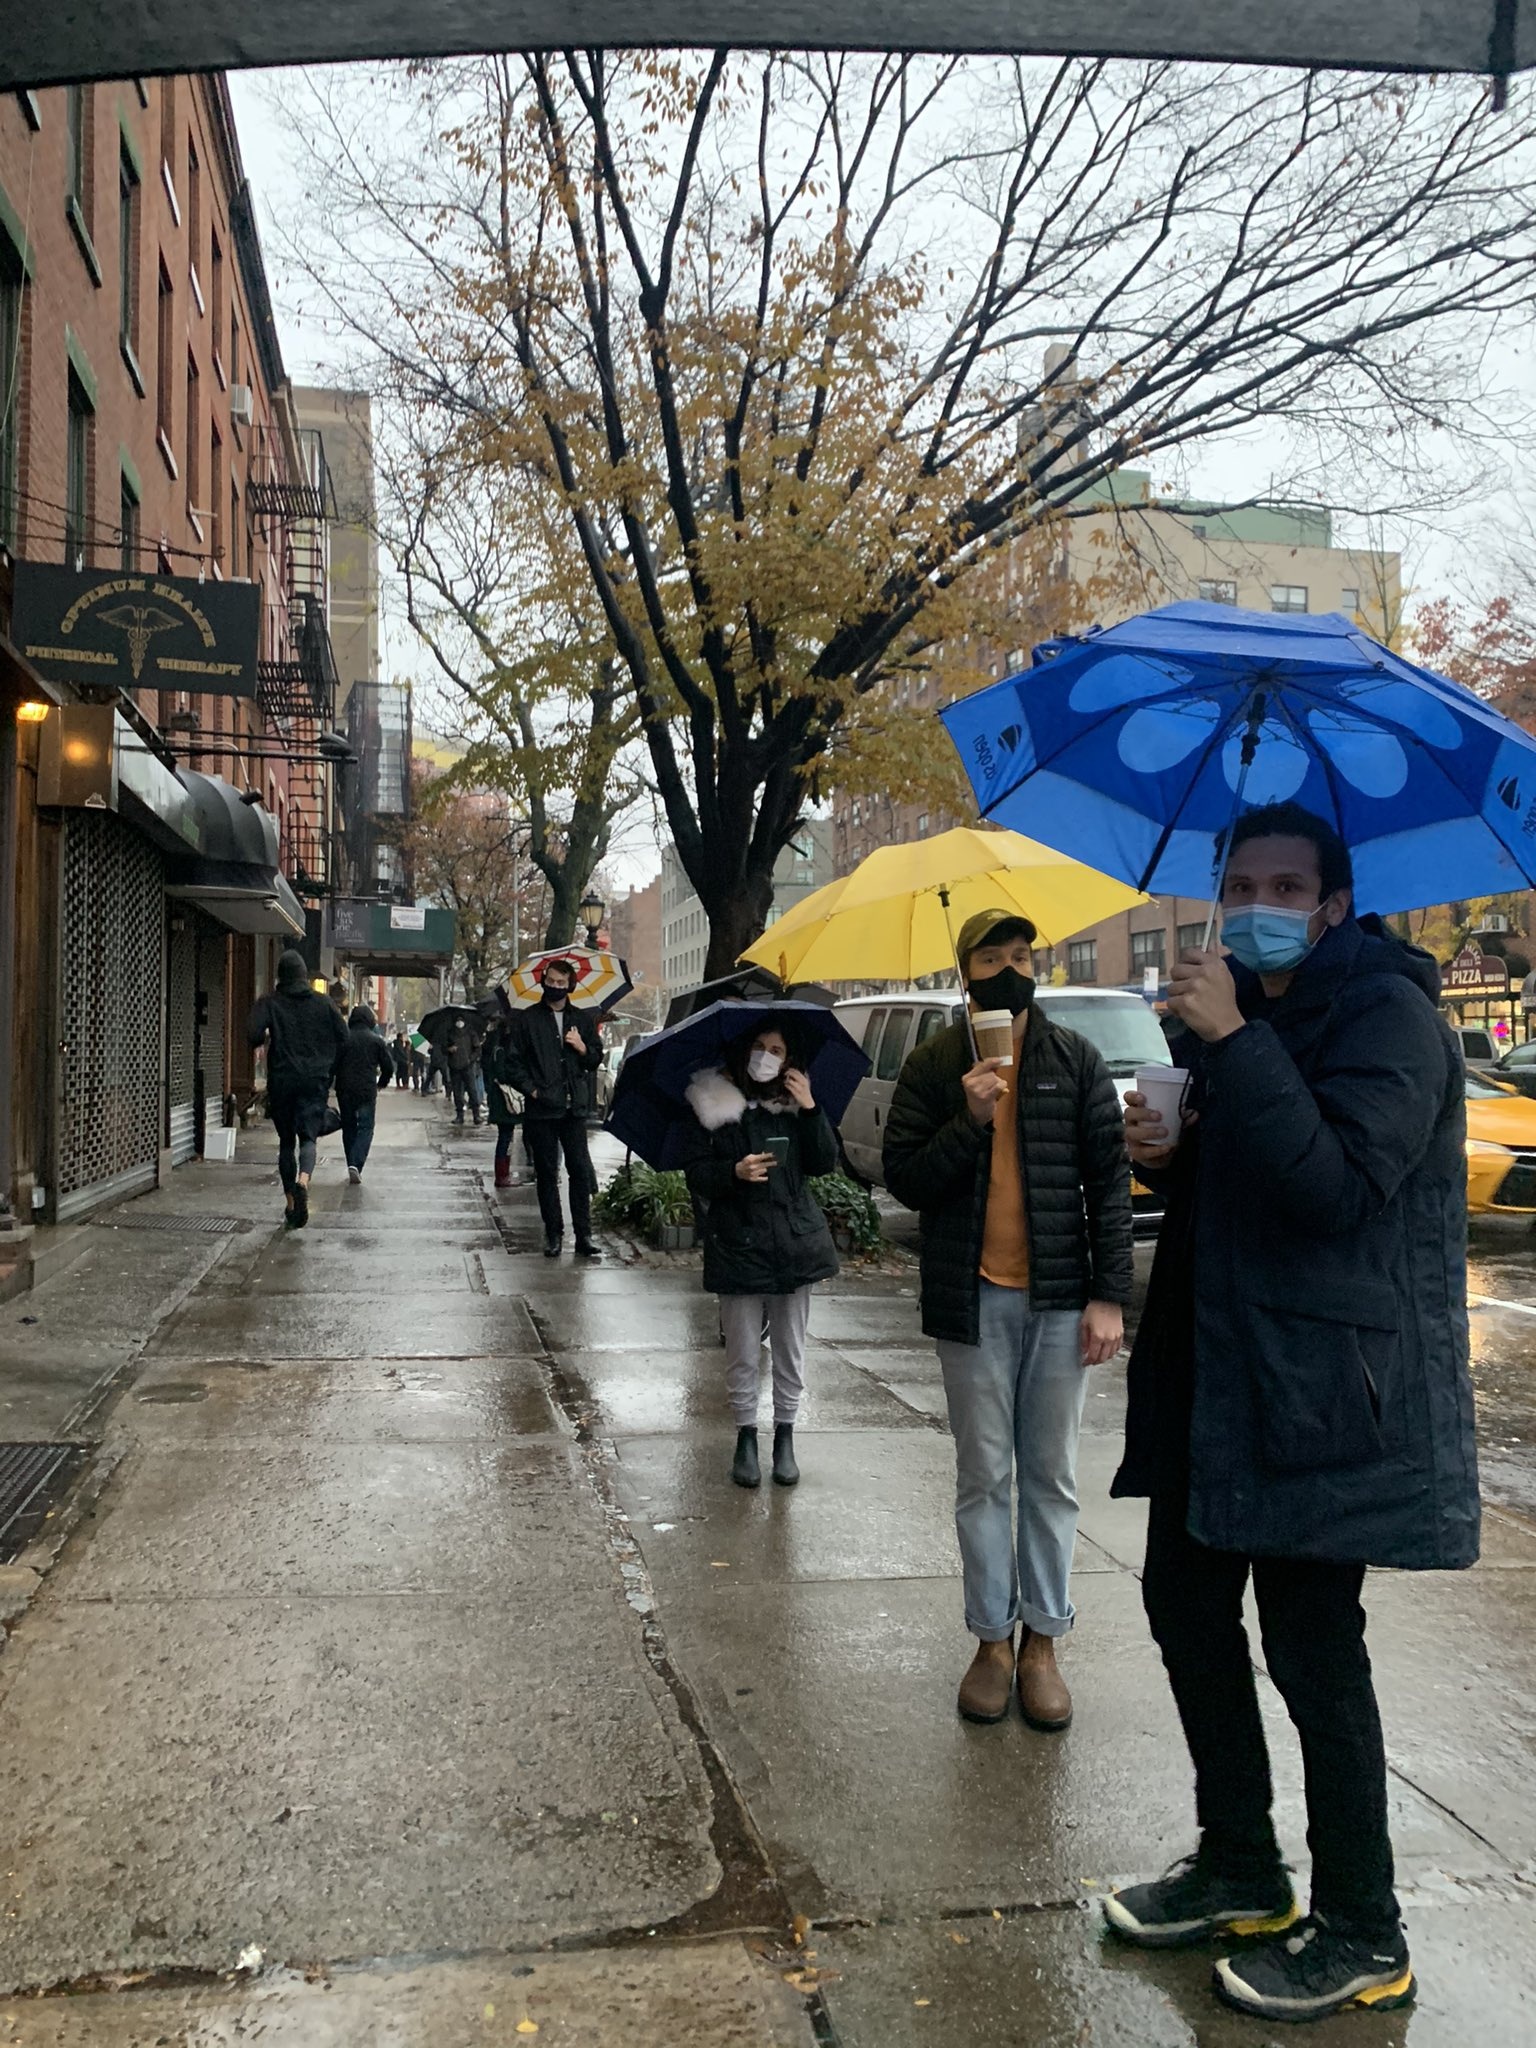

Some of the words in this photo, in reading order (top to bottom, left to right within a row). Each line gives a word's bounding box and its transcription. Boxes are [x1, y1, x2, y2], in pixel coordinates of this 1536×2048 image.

[60, 579, 146, 634] OPTIMUM
[152, 582, 217, 648] HEALTH
[26, 645, 119, 665] PHYSICAL
[156, 657, 243, 676] THERAPY
[336, 907, 354, 918] five
[1451, 968, 1482, 985] PIZZA
